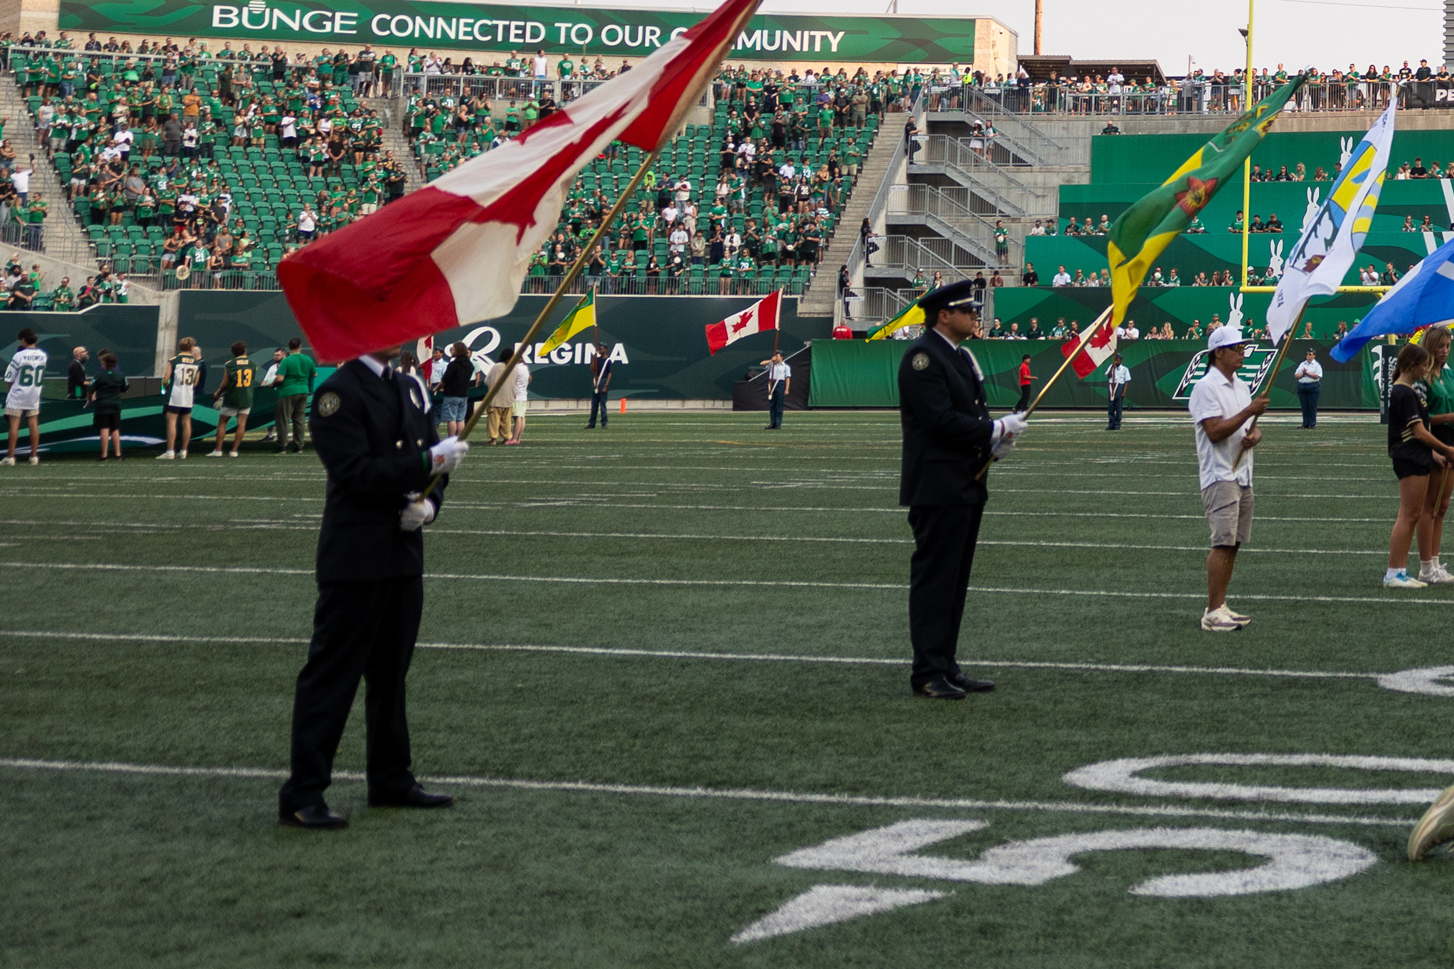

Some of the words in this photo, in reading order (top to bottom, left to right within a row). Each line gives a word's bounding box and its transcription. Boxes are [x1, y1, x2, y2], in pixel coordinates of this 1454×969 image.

[211, 3, 358, 34] BUNGE
[371, 14, 545, 43] CONNECTED
[554, 22, 593, 45] TO
[600, 24, 661, 47] OUR
[670, 27, 846, 52] CMUNITY
[19, 364, 46, 387] 60
[180, 367, 195, 386] 13
[236, 368, 253, 388] 13
